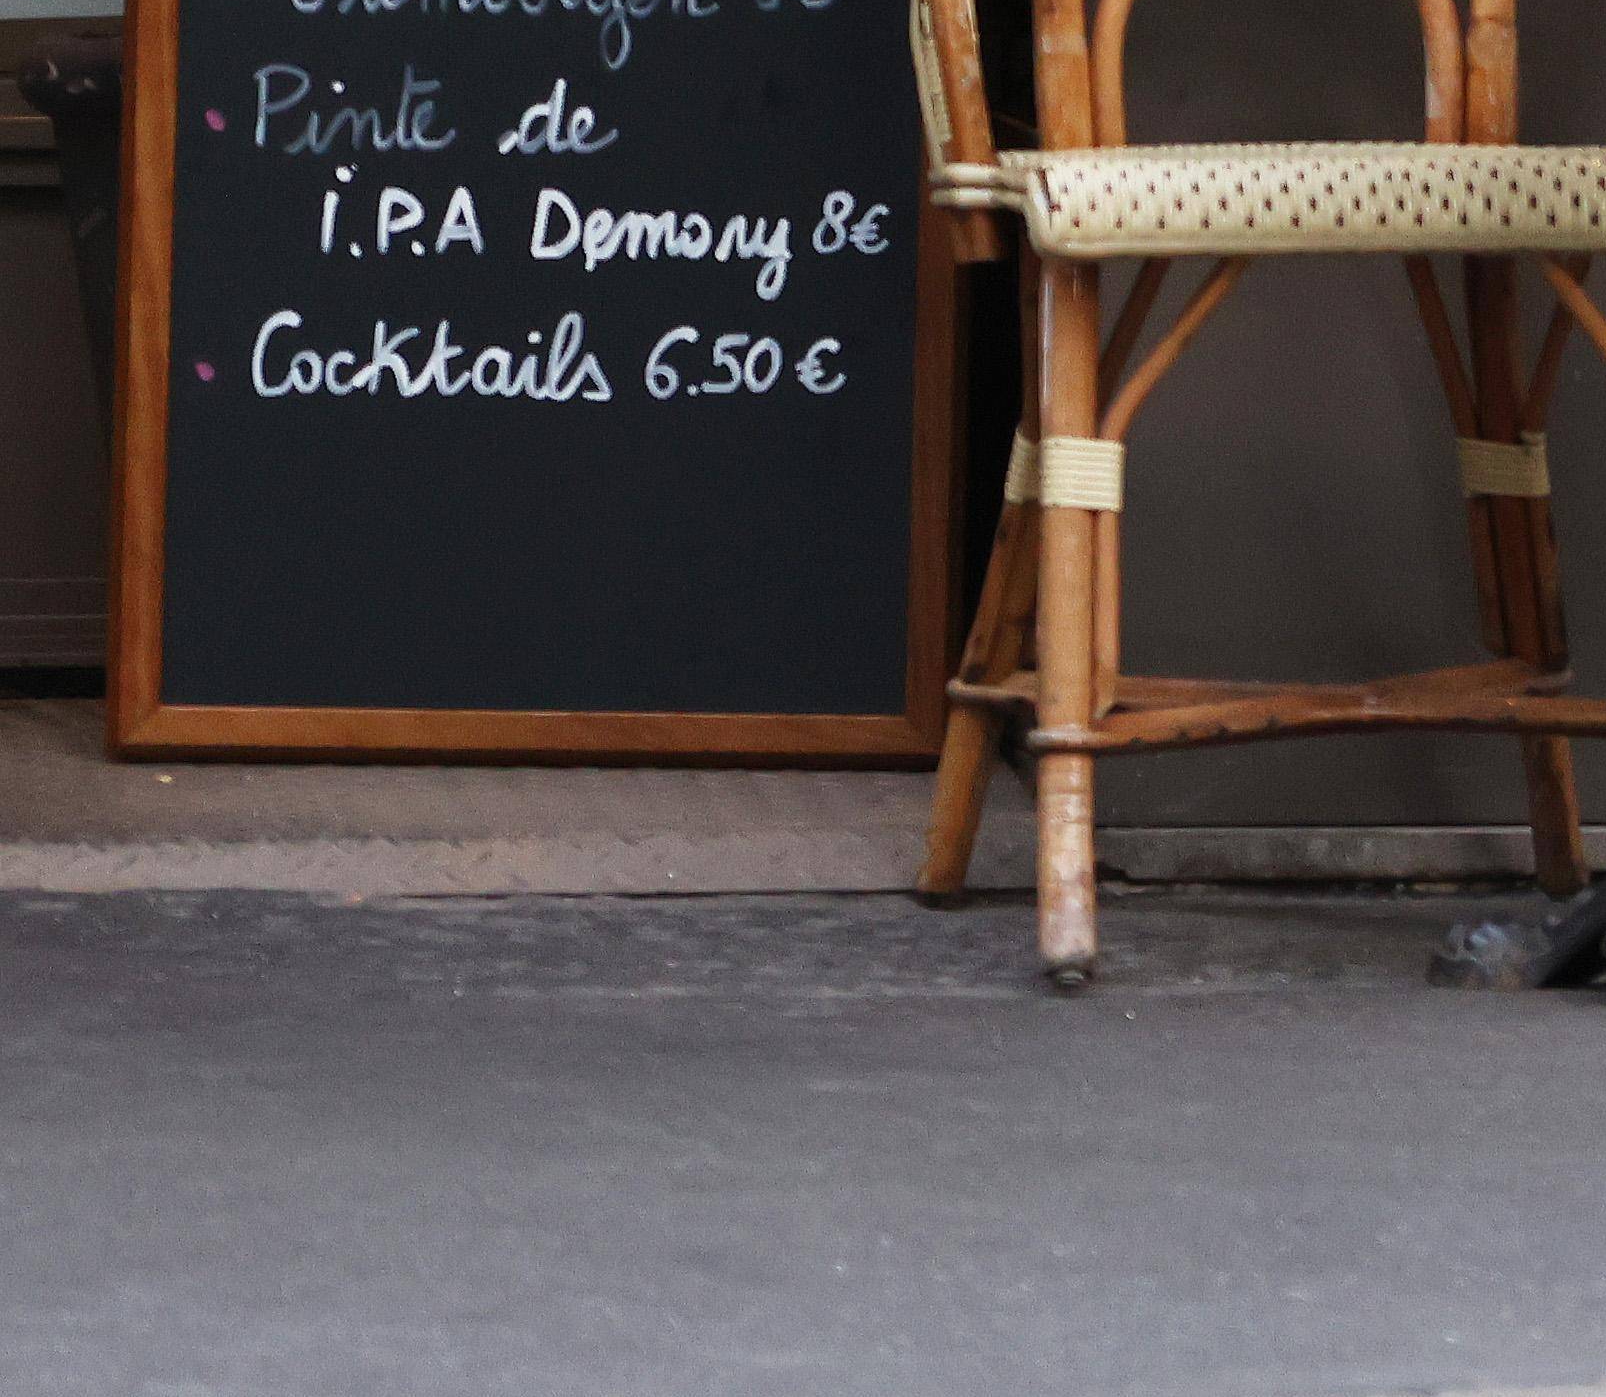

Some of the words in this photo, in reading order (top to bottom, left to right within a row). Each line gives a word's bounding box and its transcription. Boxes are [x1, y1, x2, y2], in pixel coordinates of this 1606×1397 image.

[255, 65, 456, 153] Pinte
[499, 78, 617, 154] de
[813, 190, 889, 254] 8€
[252, 310, 612, 401] Cocktails
